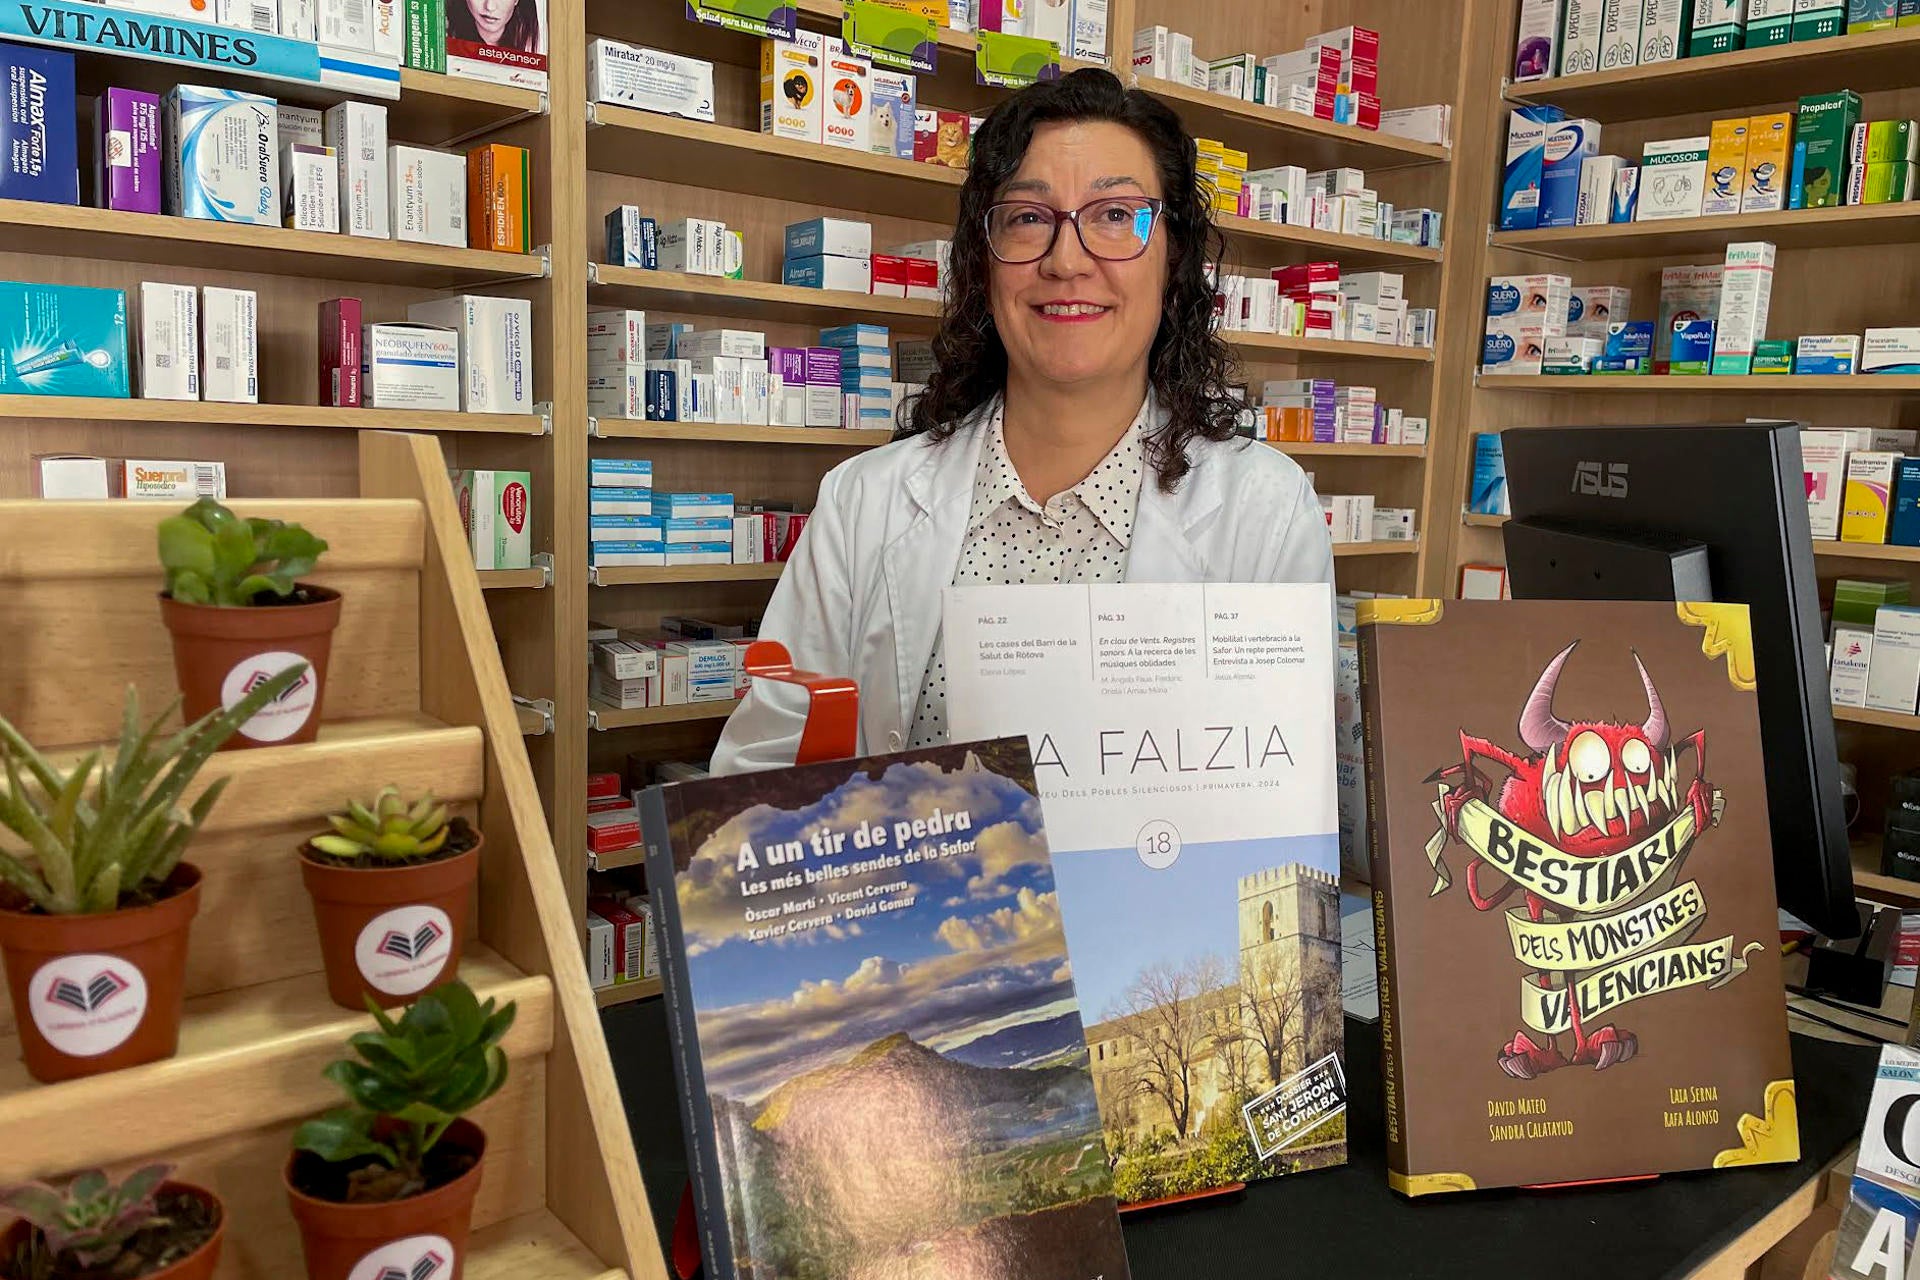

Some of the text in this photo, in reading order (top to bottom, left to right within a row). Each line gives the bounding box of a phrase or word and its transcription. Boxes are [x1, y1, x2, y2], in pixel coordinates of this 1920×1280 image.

[378, 4, 390, 37] Acutil
[696, 8, 791, 39] Salud para tus mascotas
[20, 4, 257, 66] VITAMINES
[411, 1, 423, 68] magnogene 53
[605, 46, 676, 72] Mirataz 20 mg/g
[850, 44, 933, 71] Salud para tus mascotas
[10, 66, 19, 81] oral
[984, 74, 1004, 87] Salud
[29, 69, 48, 126] Almax
[140, 102, 148, 115] 875
[20, 109, 29, 125] oral
[30, 129, 41, 156] Forte
[1510, 130, 1543, 140] Mucosan
[1547, 134, 1573, 143] MUCOSAN
[1854, 125, 1865, 164] PROSPANTUS
[12, 138, 20, 173] Almagate
[21, 140, 29, 174] Almagato
[1650, 152, 1700, 165] MUCOSOR
[416, 160, 424, 233] solución oral en sobre
[1852, 166, 1863, 203] PROSPANTUS
[256, 186, 273, 216] Baby
[300, 194, 308, 227] Citicolina
[355, 194, 363, 230] Enantyum
[405, 185, 416, 231] Enantyum
[1578, 192, 1587, 225] MUCOSAN
[496, 196, 506, 246] ESPIDIFEN
[789, 268, 805, 280] Almax
[1492, 290, 1518, 300] SUERO
[114, 313, 124, 326] 12
[375, 338, 448, 353] NEOBRUFEN 600
[376, 350, 413, 360] granulado
[1487, 339, 1512, 350] SUERO
[348, 375, 357, 404] Monurol
[1571, 461, 1629, 498] ASUS
[997, 616, 1008, 624] 22
[1116, 614, 1125, 622] 33
[1230, 612, 1239, 620] 37
[979, 640, 995, 649] Les
[1020, 640, 1035, 648] del
[1036, 638, 1055, 647] Barri
[1056, 638, 1068, 646] de
[1069, 638, 1077, 646] la
[1099, 636, 1196, 646] En clau de Registres
[1212, 635, 1243, 643] Mobilitat
[1248, 634, 1287, 642] vertebració
[1294, 634, 1301, 642] la
[1234, 646, 1244, 654] Un
[1246, 647, 1265, 656] repte
[698, 654, 726, 663] DEMILOS
[980, 650, 1045, 660] Salut de Ròtova
[1134, 648, 1142, 657] la
[1144, 648, 1172, 656] recerca
[1174, 648, 1184, 656] de
[1184, 648, 1196, 656] les
[1138, 659, 1176, 667] oblidades
[1213, 658, 1248, 666] Entrevista
[1255, 657, 1275, 667] Josep
[1100, 724, 1295, 776] FALZIA
[1258, 780, 1281, 788] 2024
[736, 808, 972, 872] A un tir de pedra
[1146, 832, 1172, 855] 18
[740, 840, 977, 898] Les més belles sendes de la Safor
[1486, 819, 1679, 906] BESTIARI
[745, 880, 909, 924] Òscar Martí Vicent Cervera
[748, 896, 916, 943] Xavier Cervera David Gomar
[1518, 886, 1699, 962] DELS MONSTRES
[1540, 944, 1726, 1030] VALENCIANS
[1374, 890, 1400, 1144] BESTIARI MONSTRES VALENCIANS
[1880, 1068, 1914, 1080] SALÓN
[1262, 1076, 1335, 1129] SANT JERONI
[1276, 1077, 1313, 1105] DOSSIER
[1690, 1086, 1718, 1104] SERNA
[1267, 1090, 1340, 1142] DE COTALBA
[1488, 1098, 1547, 1118] DAVID MATEO
[1664, 1109, 1720, 1128] RAFA ALONSO
[1489, 1120, 1574, 1143] SANDRA CALATAYUD
